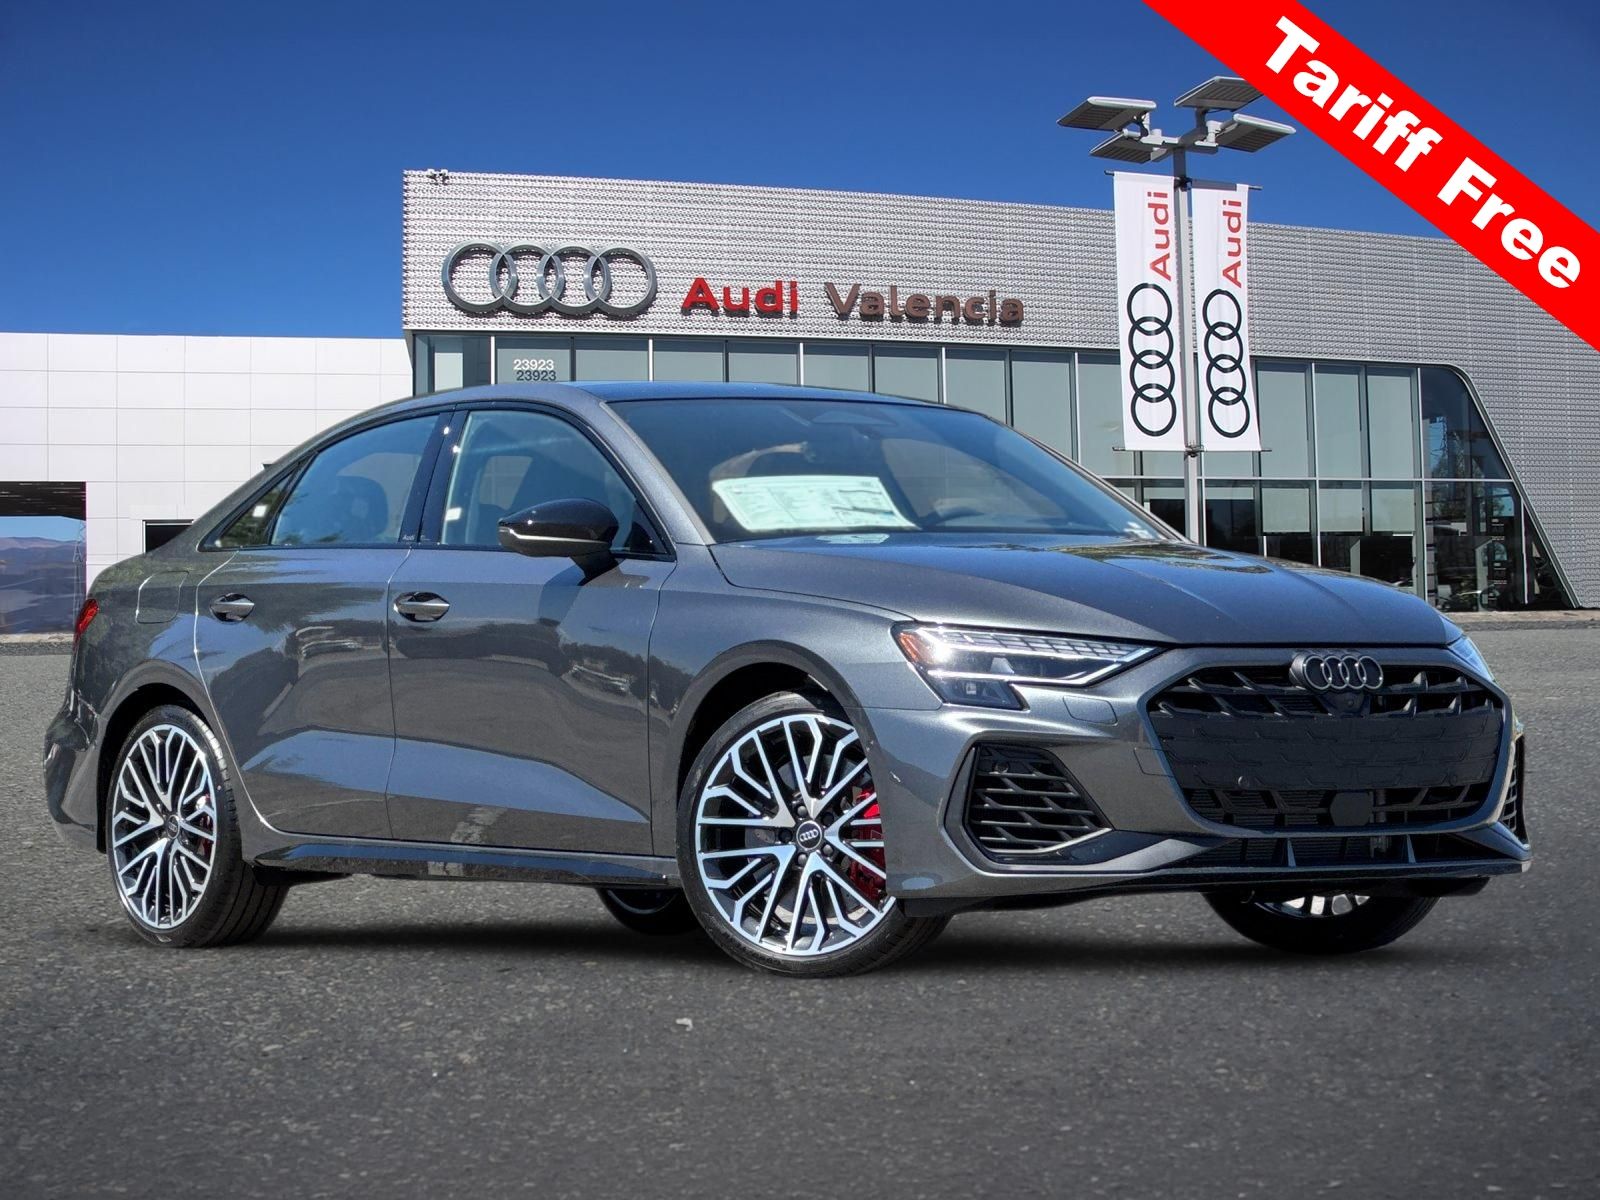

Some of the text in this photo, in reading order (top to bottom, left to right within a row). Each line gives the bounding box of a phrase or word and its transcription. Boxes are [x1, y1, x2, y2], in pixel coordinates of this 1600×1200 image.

[1147, 191, 1172, 282] Audi
[1222, 199, 1243, 289] Audi
[681, 276, 1025, 325] Audi Valencia
[513, 359, 554, 370] 23923
